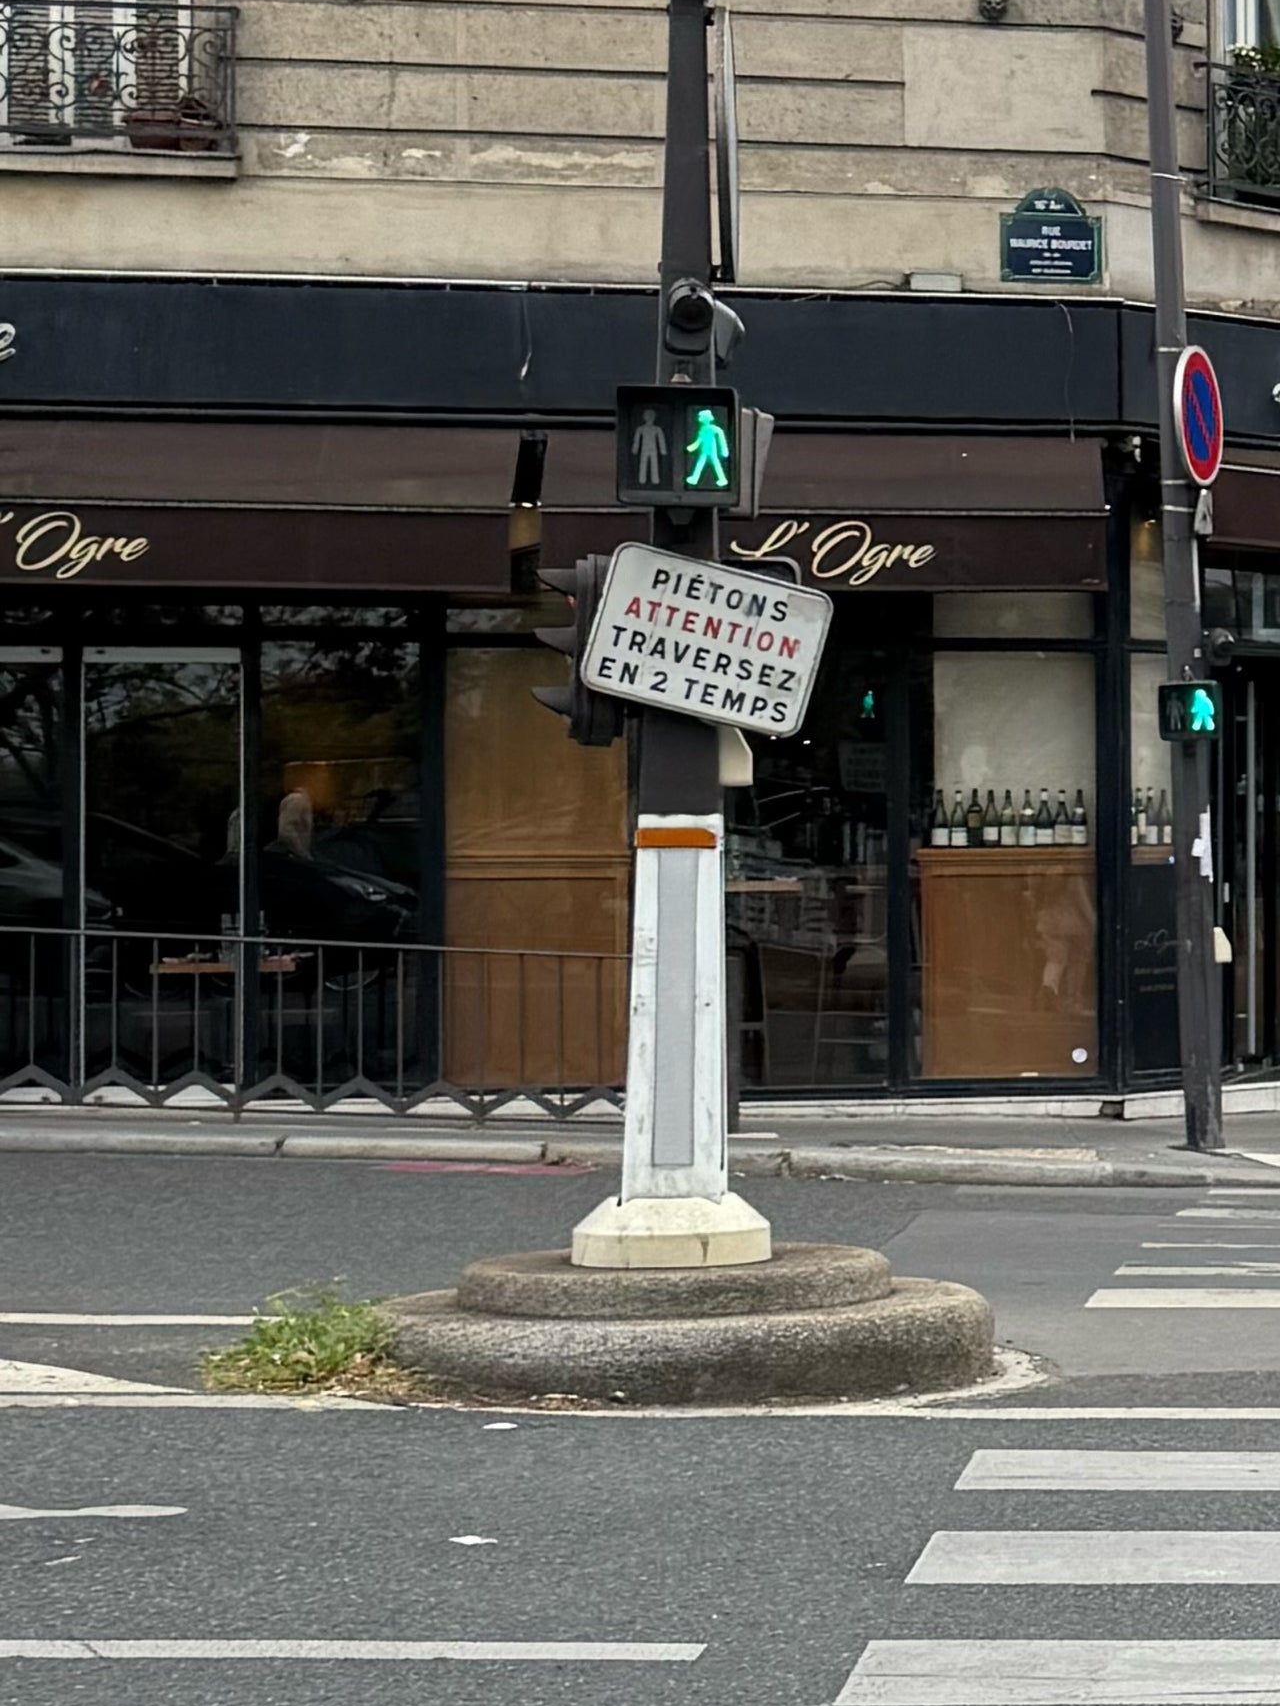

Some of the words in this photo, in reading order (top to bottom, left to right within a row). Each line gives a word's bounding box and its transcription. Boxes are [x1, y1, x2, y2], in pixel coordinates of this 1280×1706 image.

[1041, 226, 1061, 236] RUE
[0, 511, 149, 579] 'Ogre
[730, 520, 937, 585] L'Ogre
[624, 596, 801, 659] ATTENTION
[652, 568, 789, 622] PIÉTONS
[598, 656, 639, 685] EN
[650, 671, 668, 692] 2
[684, 677, 788, 722] TEMPS
[612, 625, 796, 692] TRAVERSEZ
